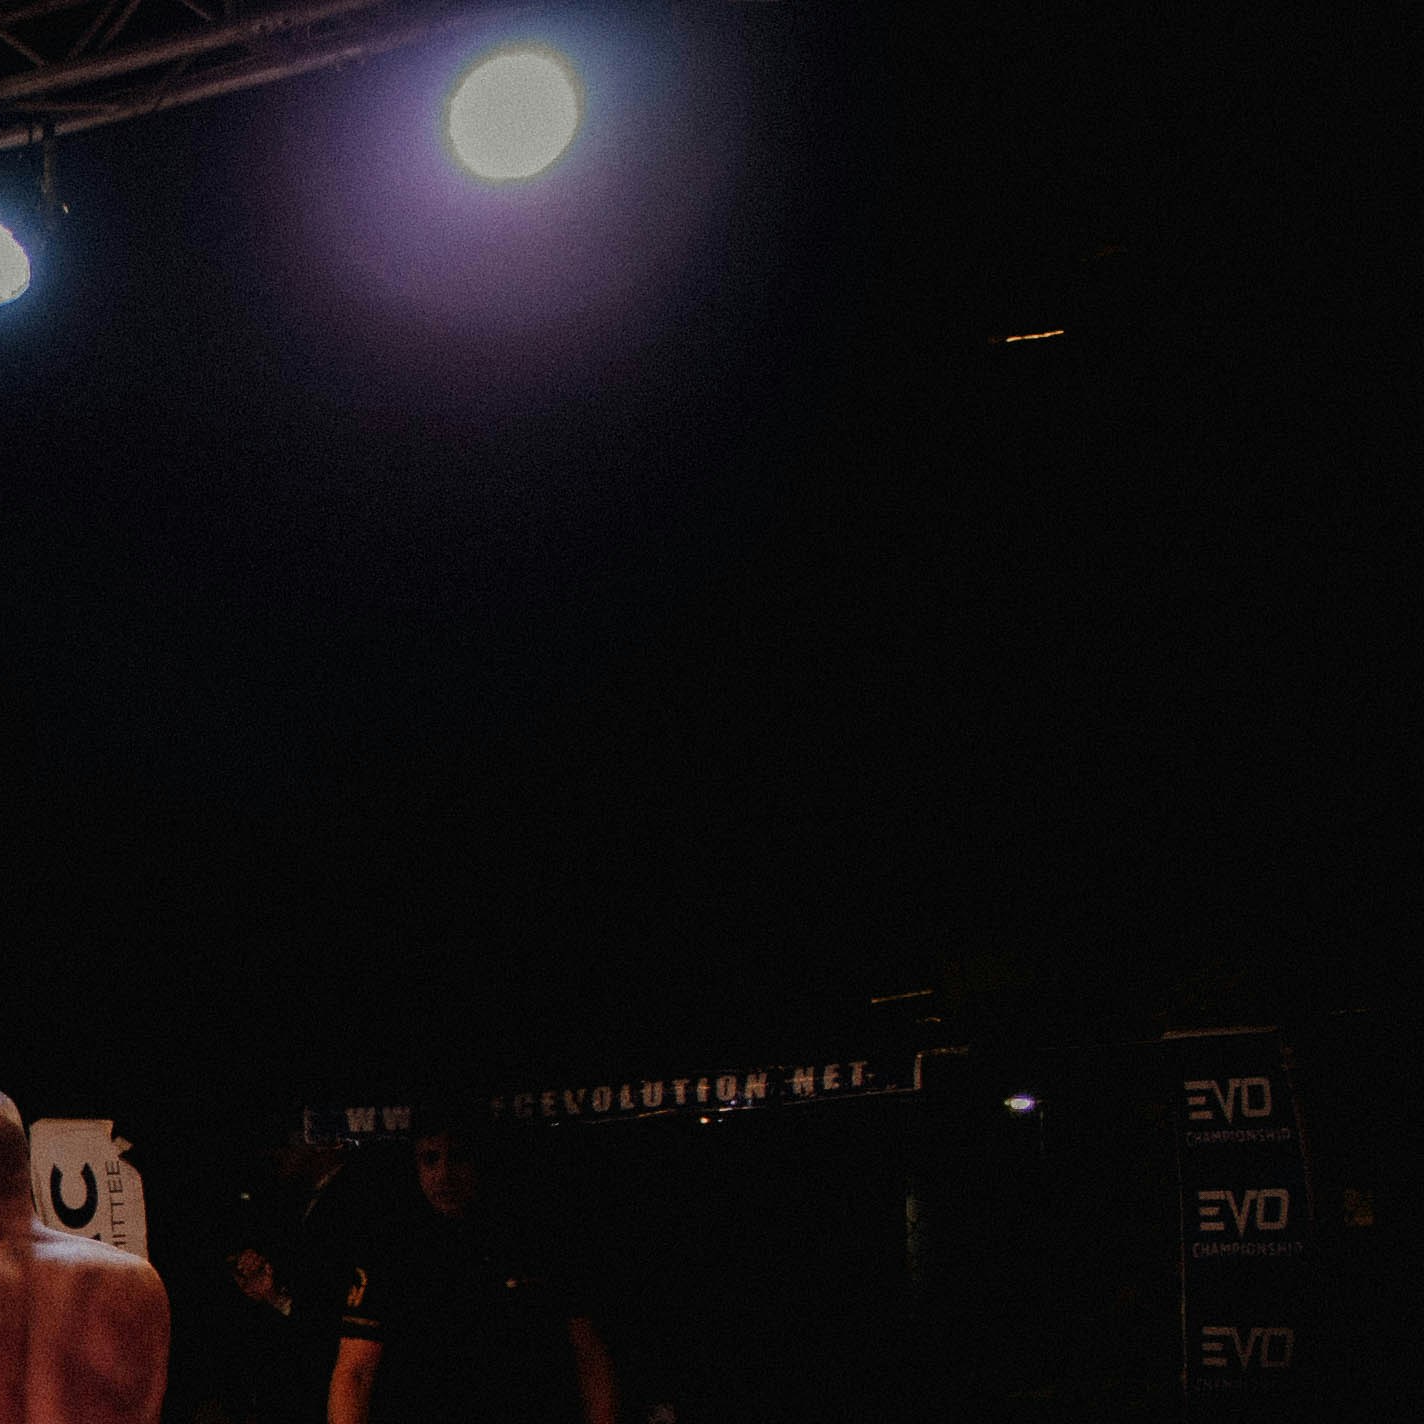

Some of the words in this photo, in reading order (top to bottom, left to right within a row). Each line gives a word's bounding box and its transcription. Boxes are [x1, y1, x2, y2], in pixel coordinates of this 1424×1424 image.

[1183, 1075, 1272, 1124] EVO
[1198, 1187, 1291, 1237] EVO
[1201, 1327, 1295, 1369] EVO
